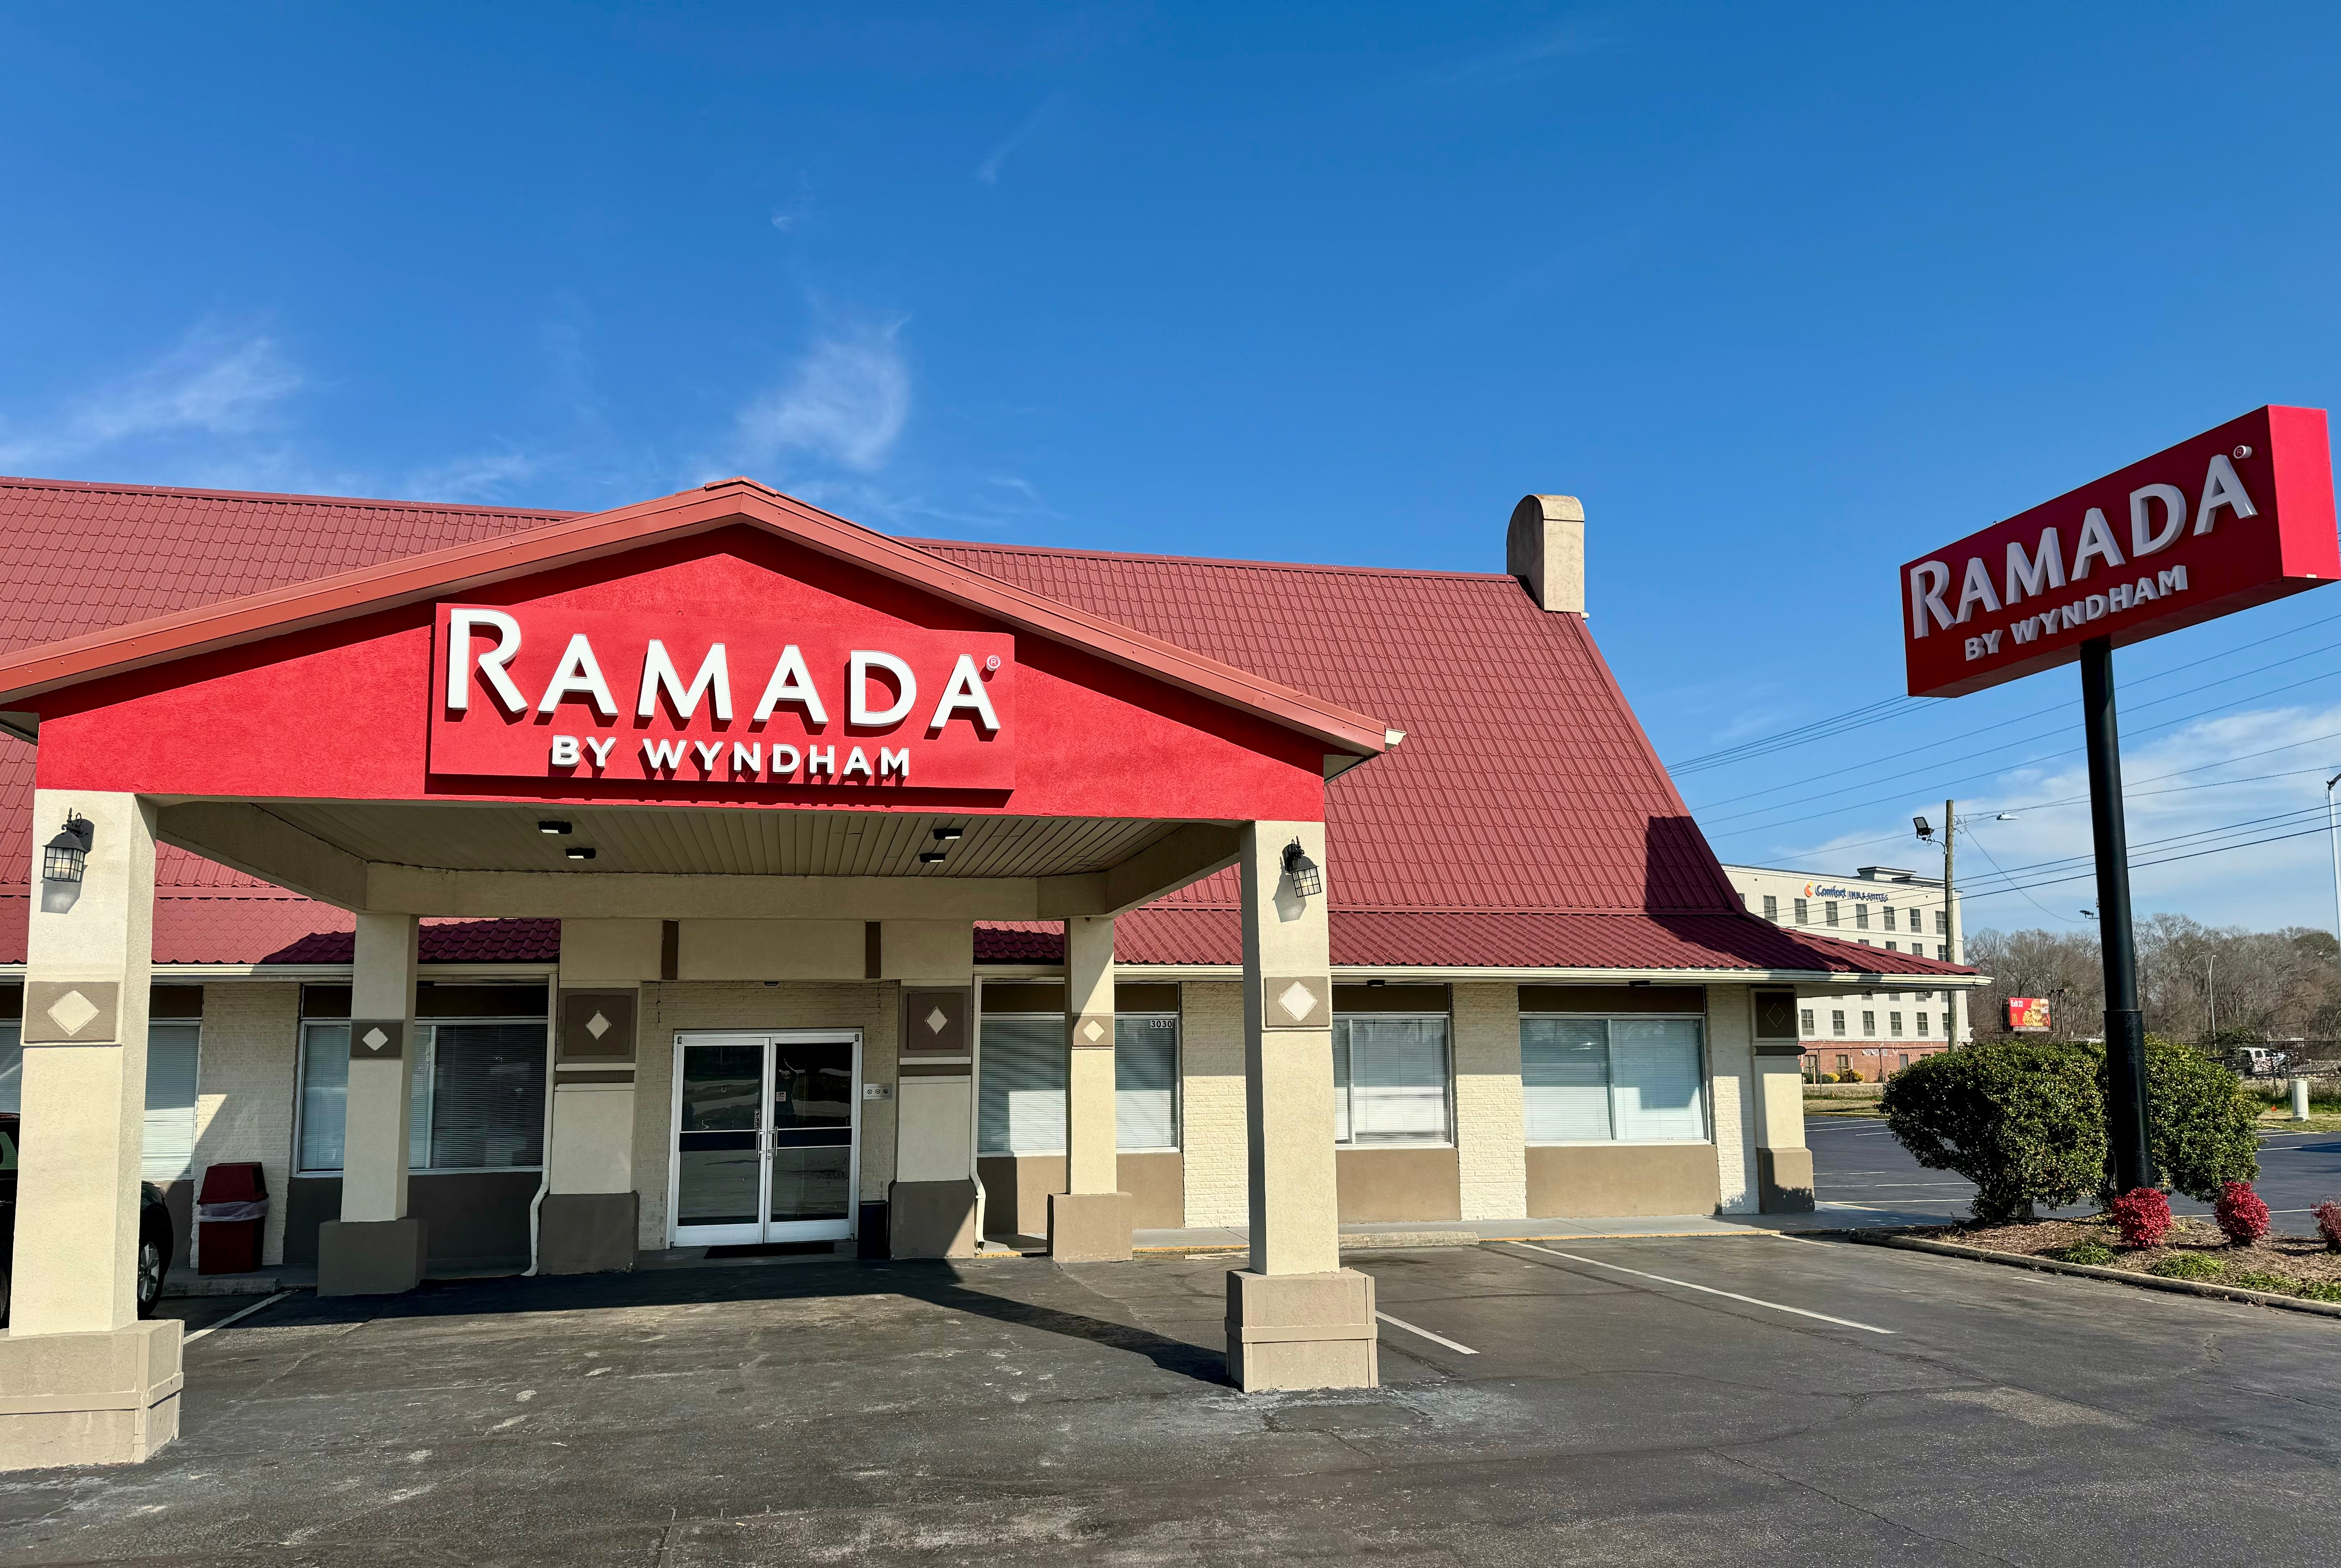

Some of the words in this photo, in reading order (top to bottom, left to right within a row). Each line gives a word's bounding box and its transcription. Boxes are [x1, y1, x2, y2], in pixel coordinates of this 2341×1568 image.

[1910, 454, 2258, 639] RAMADA
[1965, 629, 2003, 661] BY
[2010, 565, 2188, 645] WYNDHAM
[448, 608, 1001, 731] RAMADA
[552, 735, 616, 768] BY
[642, 738, 910, 777] WYNDHAM
[1815, 884, 1846, 898] Comfort
